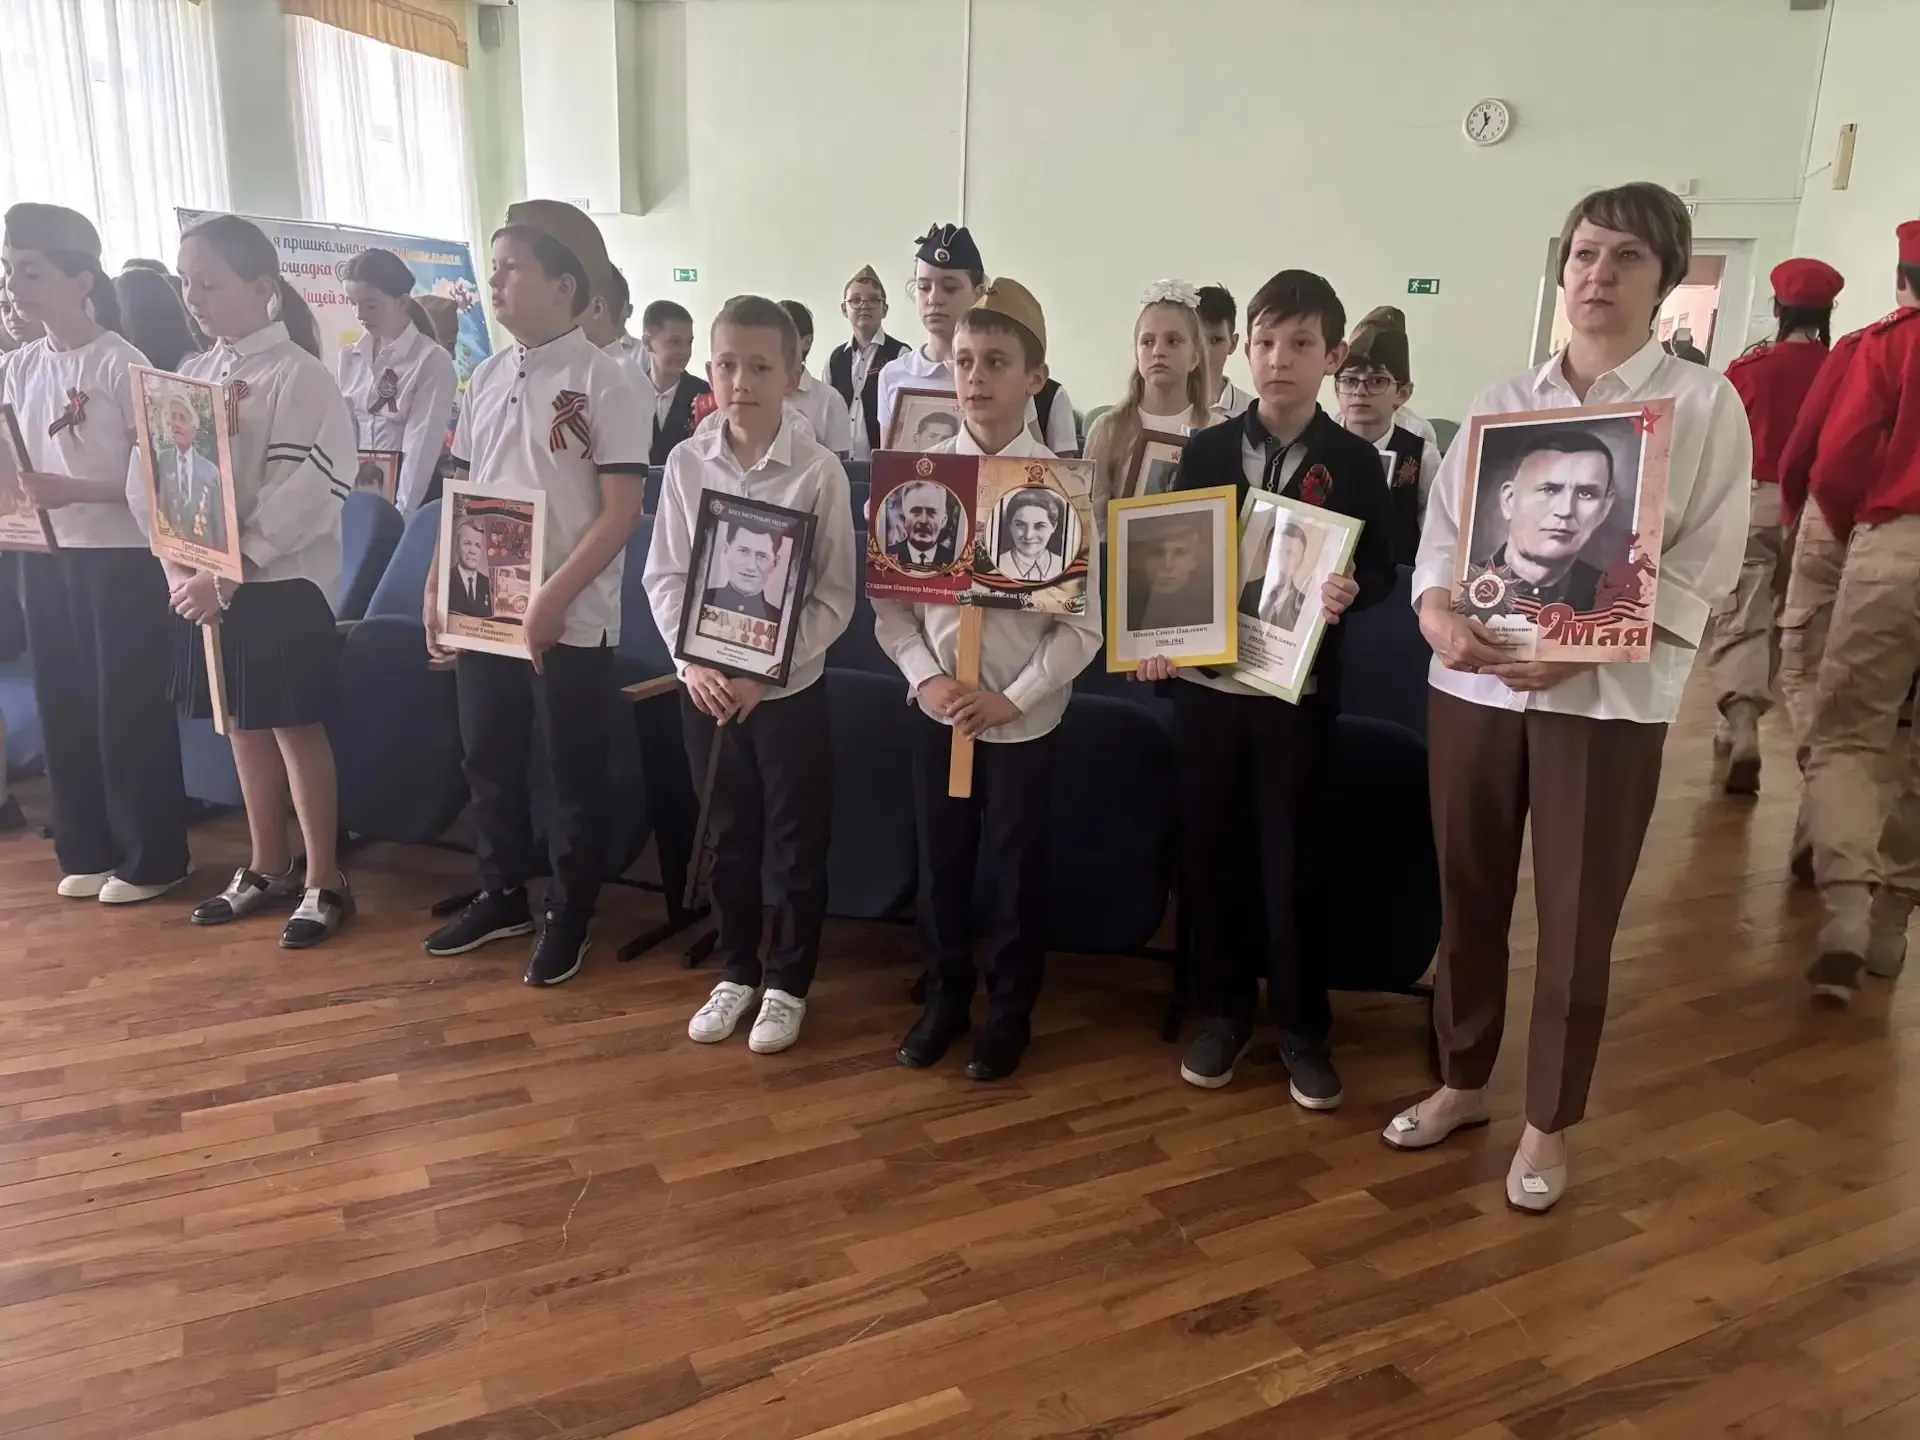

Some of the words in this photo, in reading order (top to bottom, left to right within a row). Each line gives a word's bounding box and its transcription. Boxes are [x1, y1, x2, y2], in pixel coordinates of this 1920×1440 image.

[280, 261, 332, 279] ощадка
[922, 585, 972, 597] Митрофан
[1537, 602, 1575, 641] 9
[1560, 620, 1649, 647] Мая
